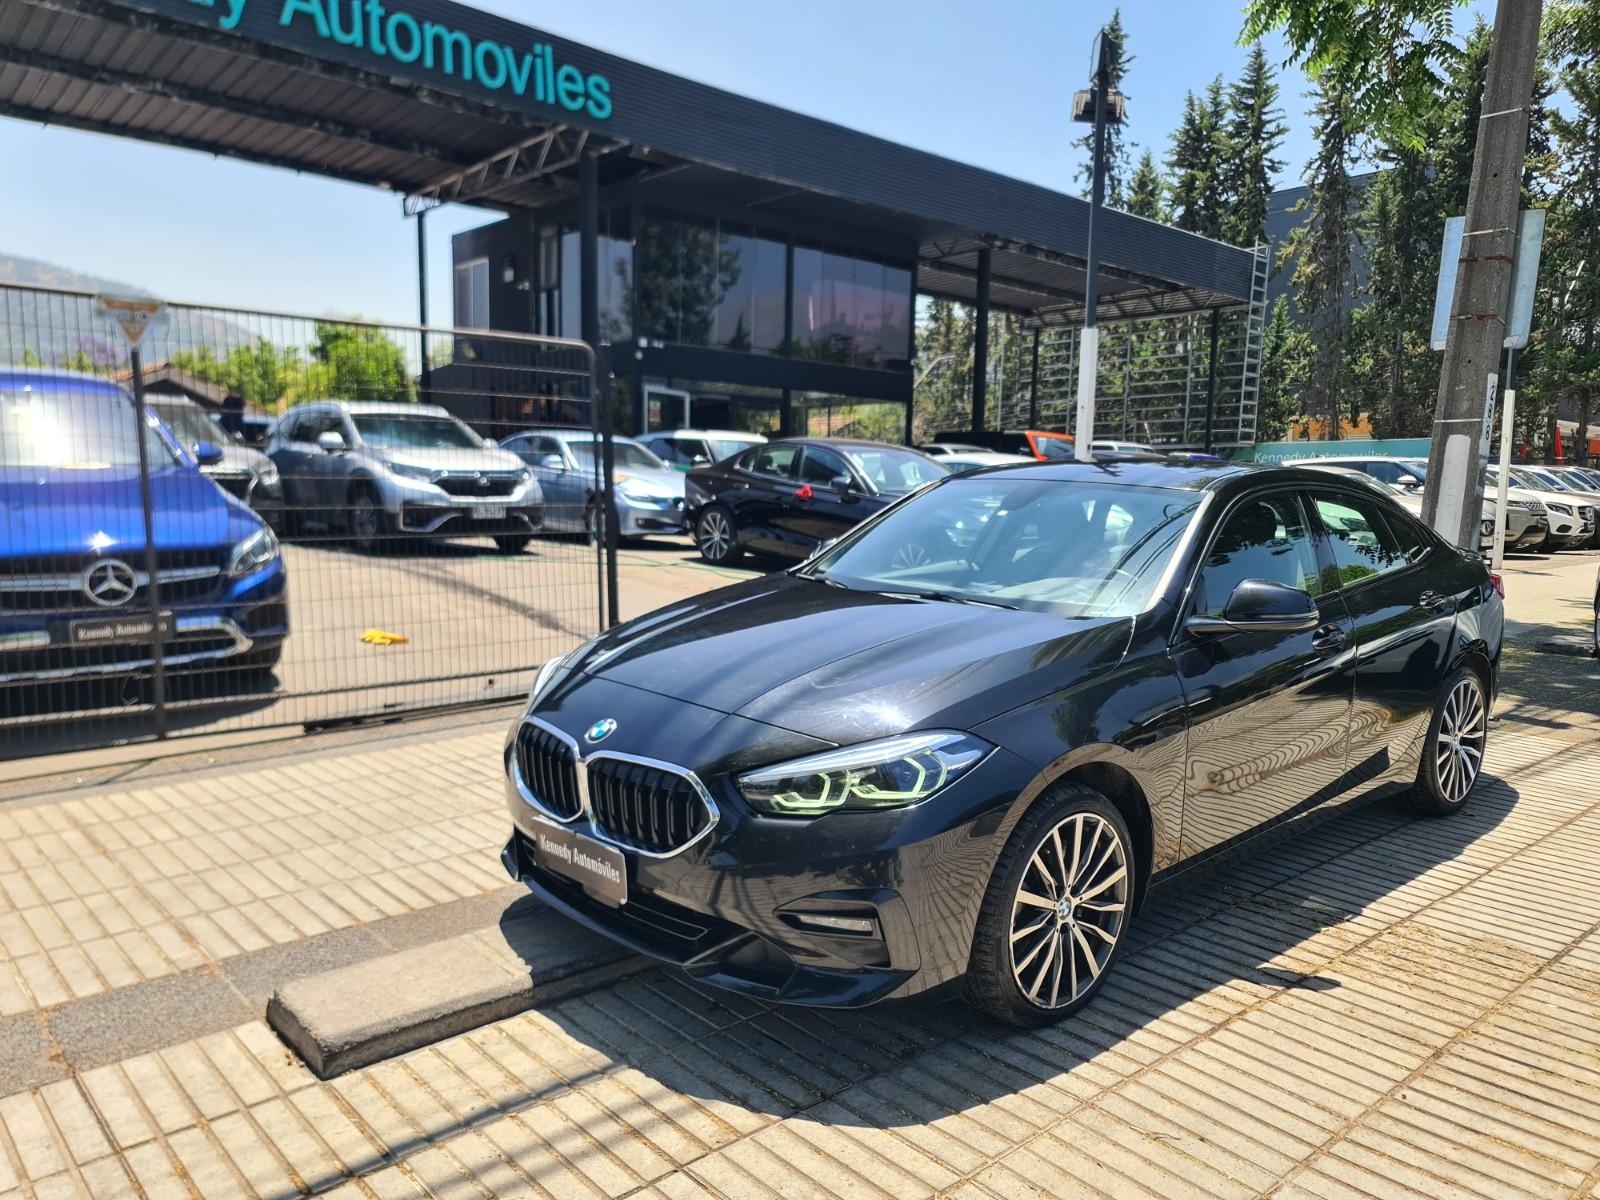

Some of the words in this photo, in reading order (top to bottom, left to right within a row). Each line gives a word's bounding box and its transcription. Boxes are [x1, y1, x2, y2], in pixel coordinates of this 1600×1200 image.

[278, 0, 613, 119] Automoviles
[540, 833, 572, 865] Kennedy
[573, 847, 621, 884] Automóviles
